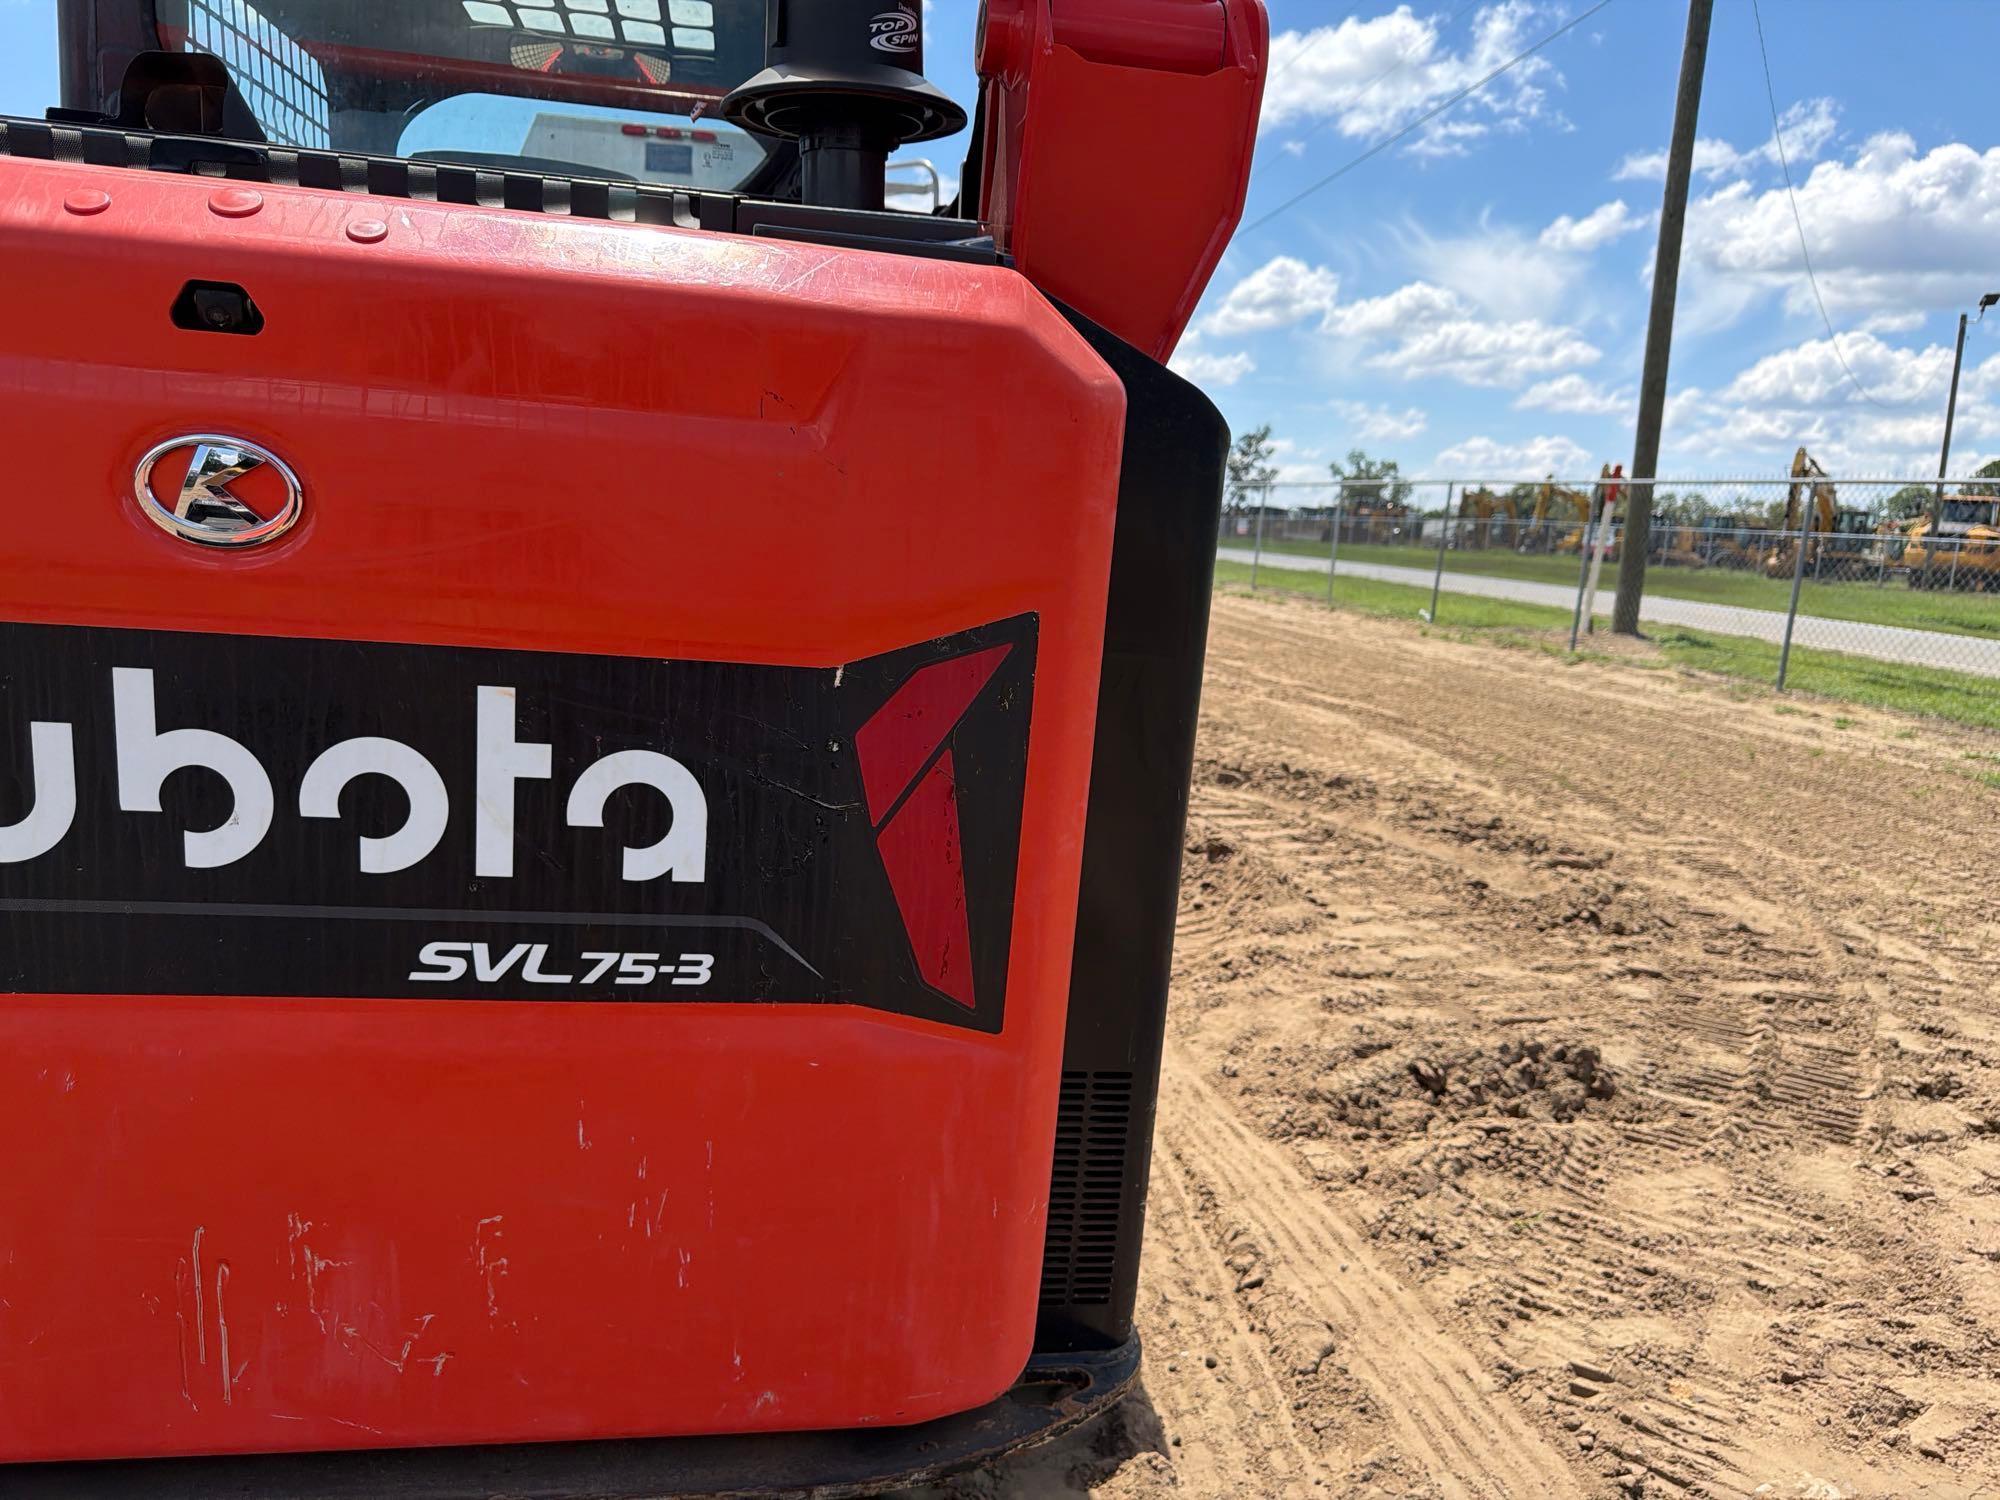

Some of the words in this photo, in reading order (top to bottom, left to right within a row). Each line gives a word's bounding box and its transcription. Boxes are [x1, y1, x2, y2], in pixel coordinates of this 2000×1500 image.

[869, 20, 905, 33] TOP
[890, 33, 919, 45] SPIN
[408, 941, 573, 984] SVL
[579, 951, 715, 985] 75-3
